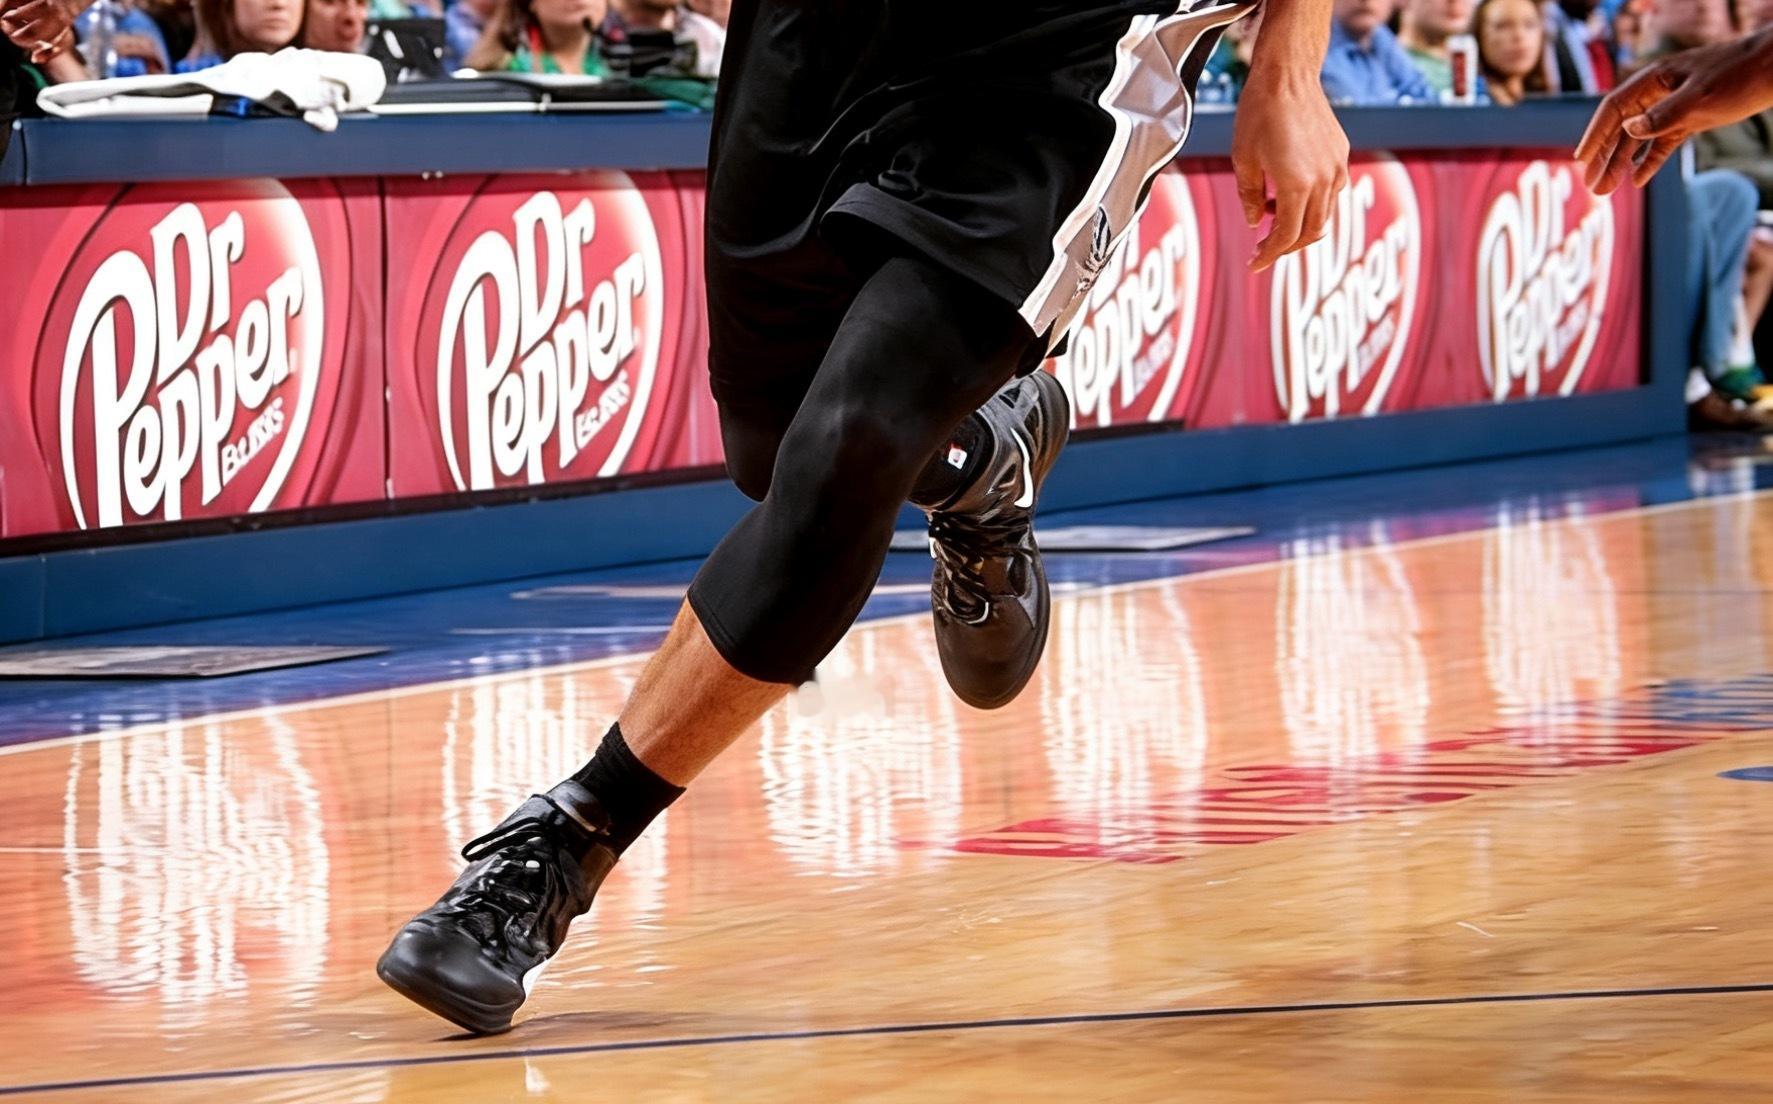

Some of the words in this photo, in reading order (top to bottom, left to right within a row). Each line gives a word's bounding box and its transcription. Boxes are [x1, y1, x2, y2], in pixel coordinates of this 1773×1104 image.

[150, 202, 245, 385] Dr
[512, 191, 595, 355] Dr
[1476, 192, 1608, 404] Pepper
[1517, 160, 1573, 284] Dr
[60, 249, 304, 531] Pepper
[437, 230, 645, 492] Pepper
